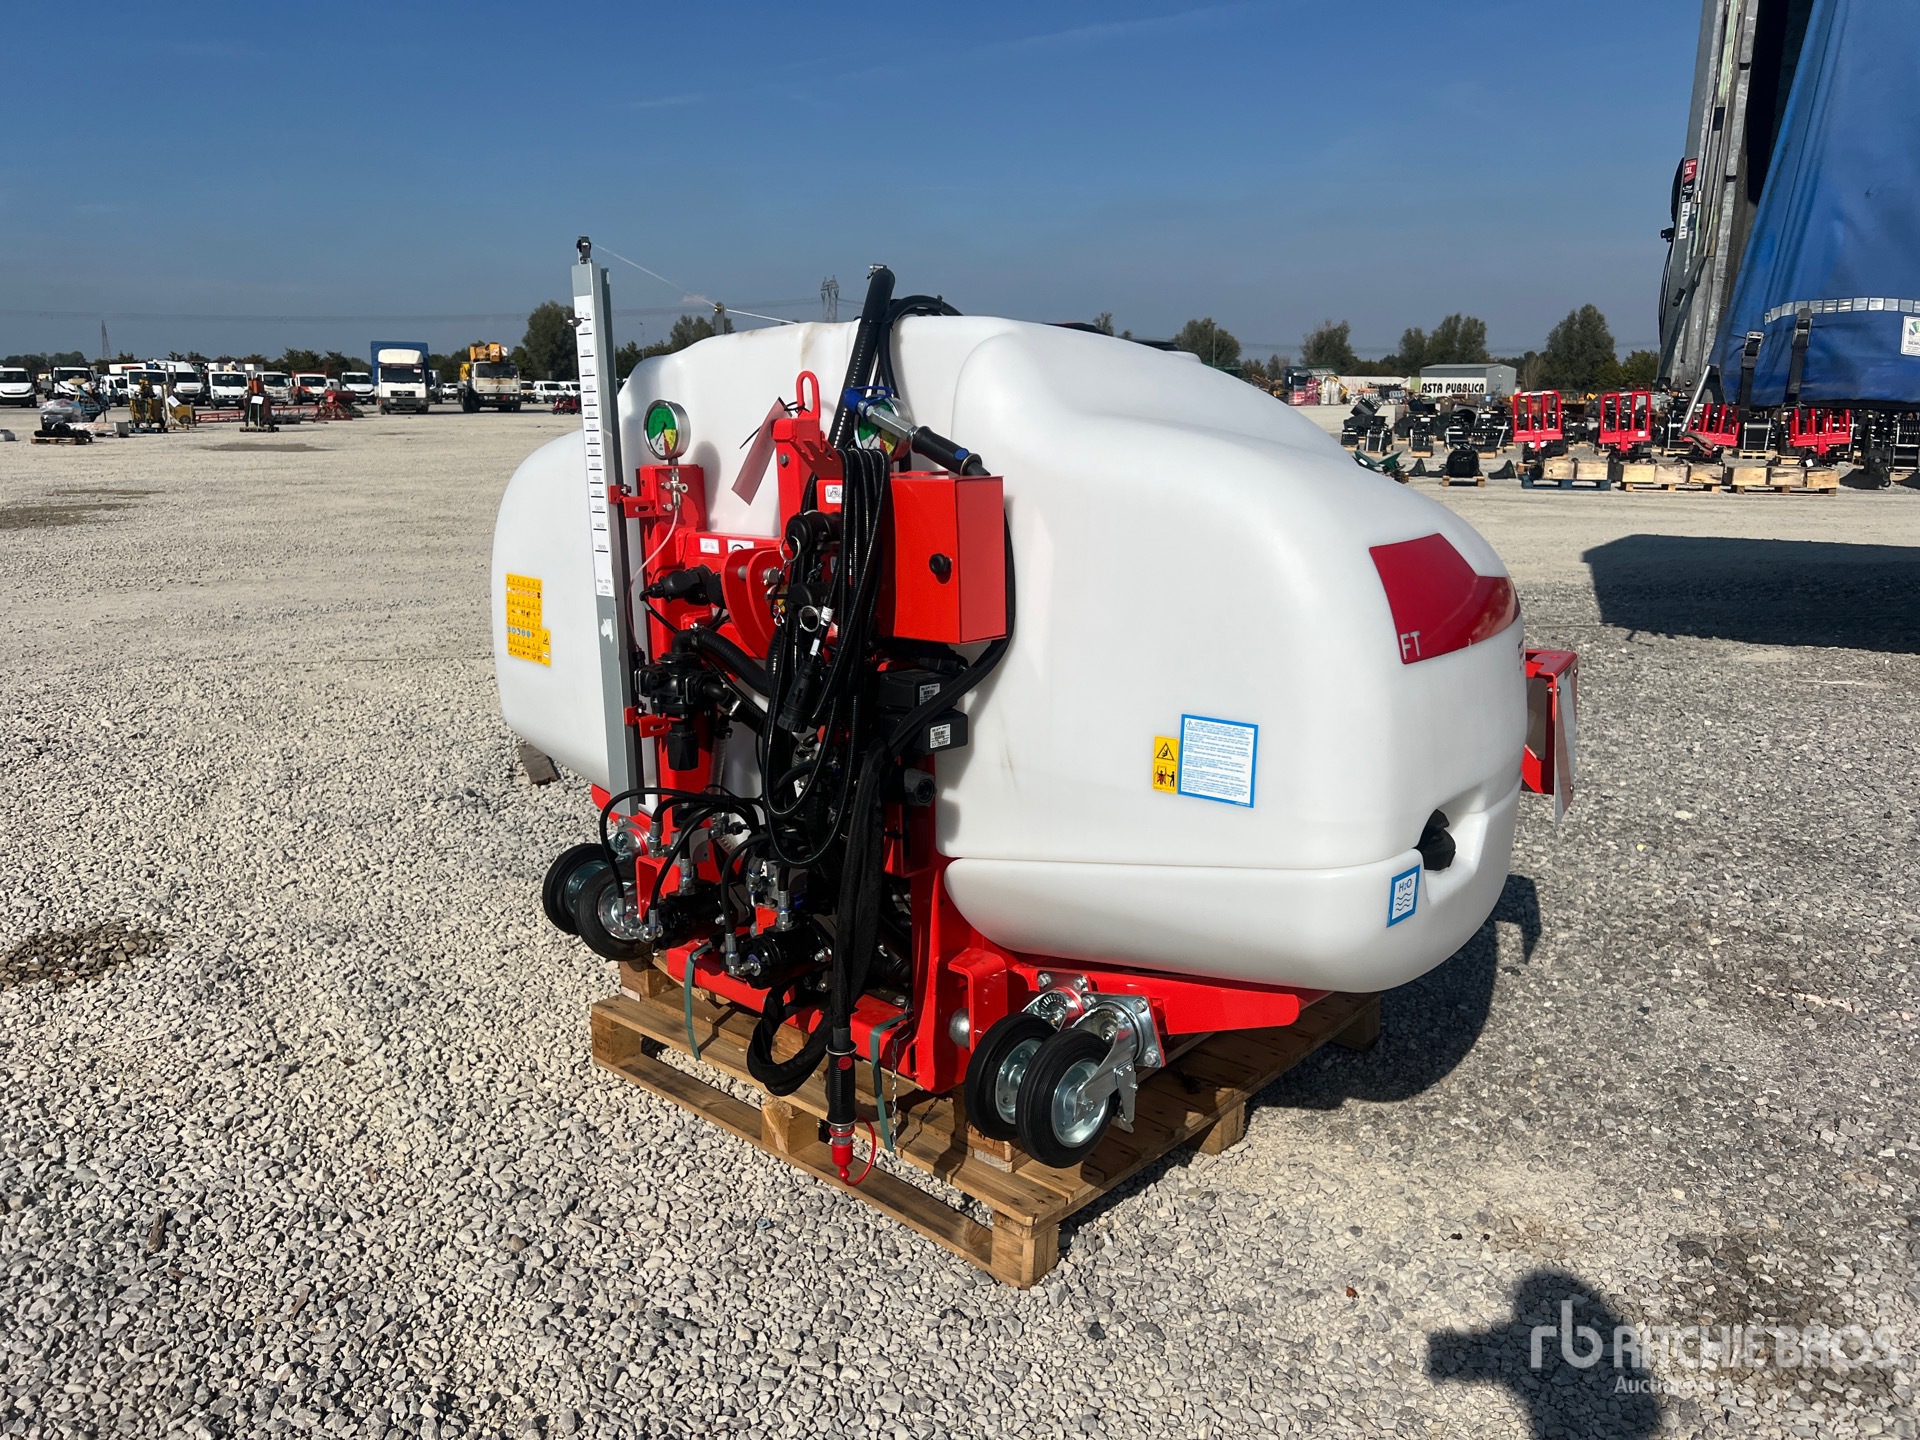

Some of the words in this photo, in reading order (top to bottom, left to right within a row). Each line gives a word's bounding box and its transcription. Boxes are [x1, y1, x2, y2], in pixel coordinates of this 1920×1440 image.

[1421, 383, 1443, 393] ASTA
[1445, 383, 1484, 393] PUBBLICA
[1400, 630, 1421, 660] FT
[1399, 878, 1412, 893] H2O
